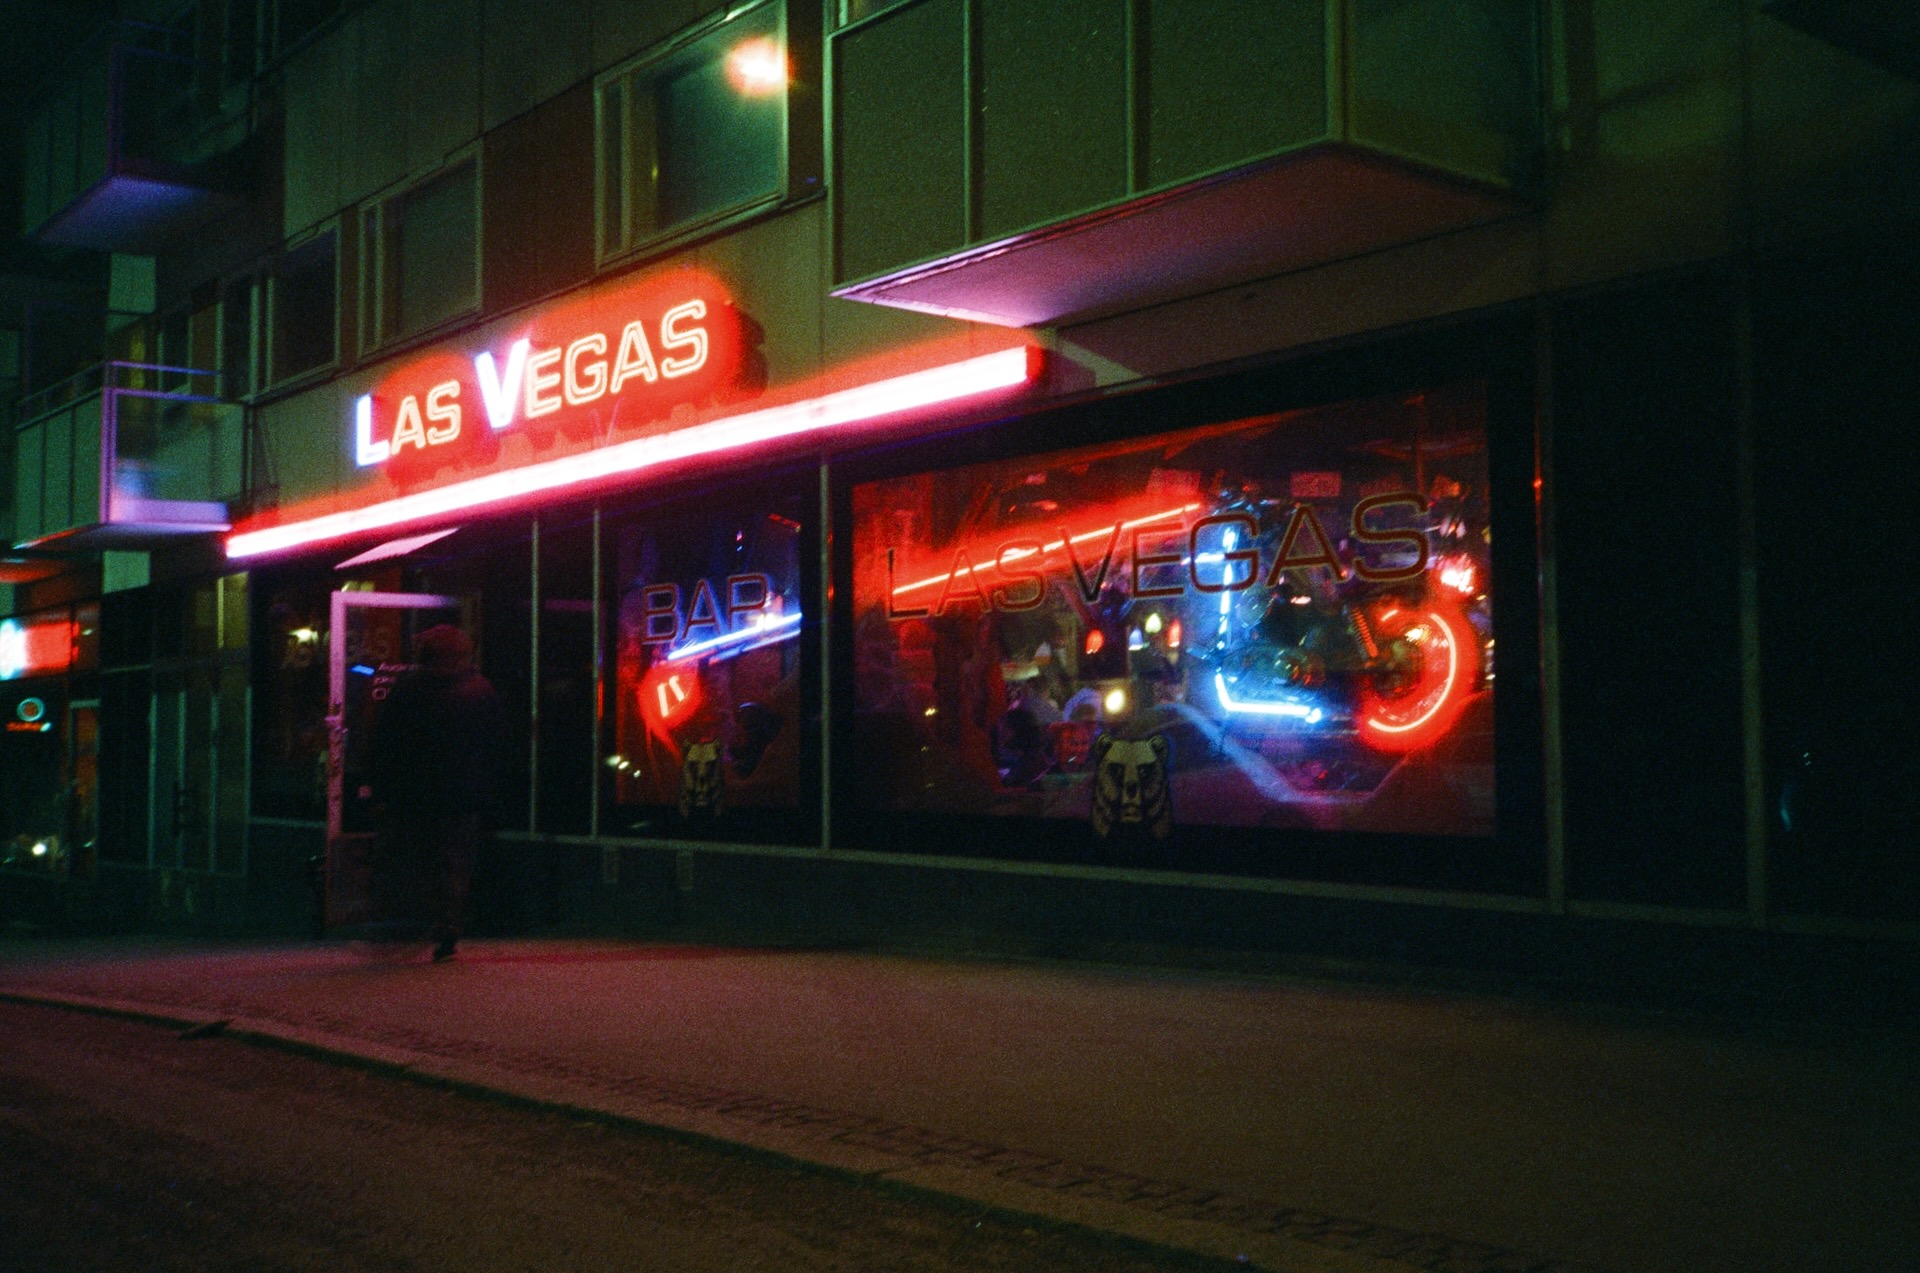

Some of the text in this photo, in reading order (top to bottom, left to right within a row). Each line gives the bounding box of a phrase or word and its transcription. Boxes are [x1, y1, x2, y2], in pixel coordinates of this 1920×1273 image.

[355, 299, 709, 467] LAS VEGAS
[887, 492, 1430, 621] LAS VEGAS
